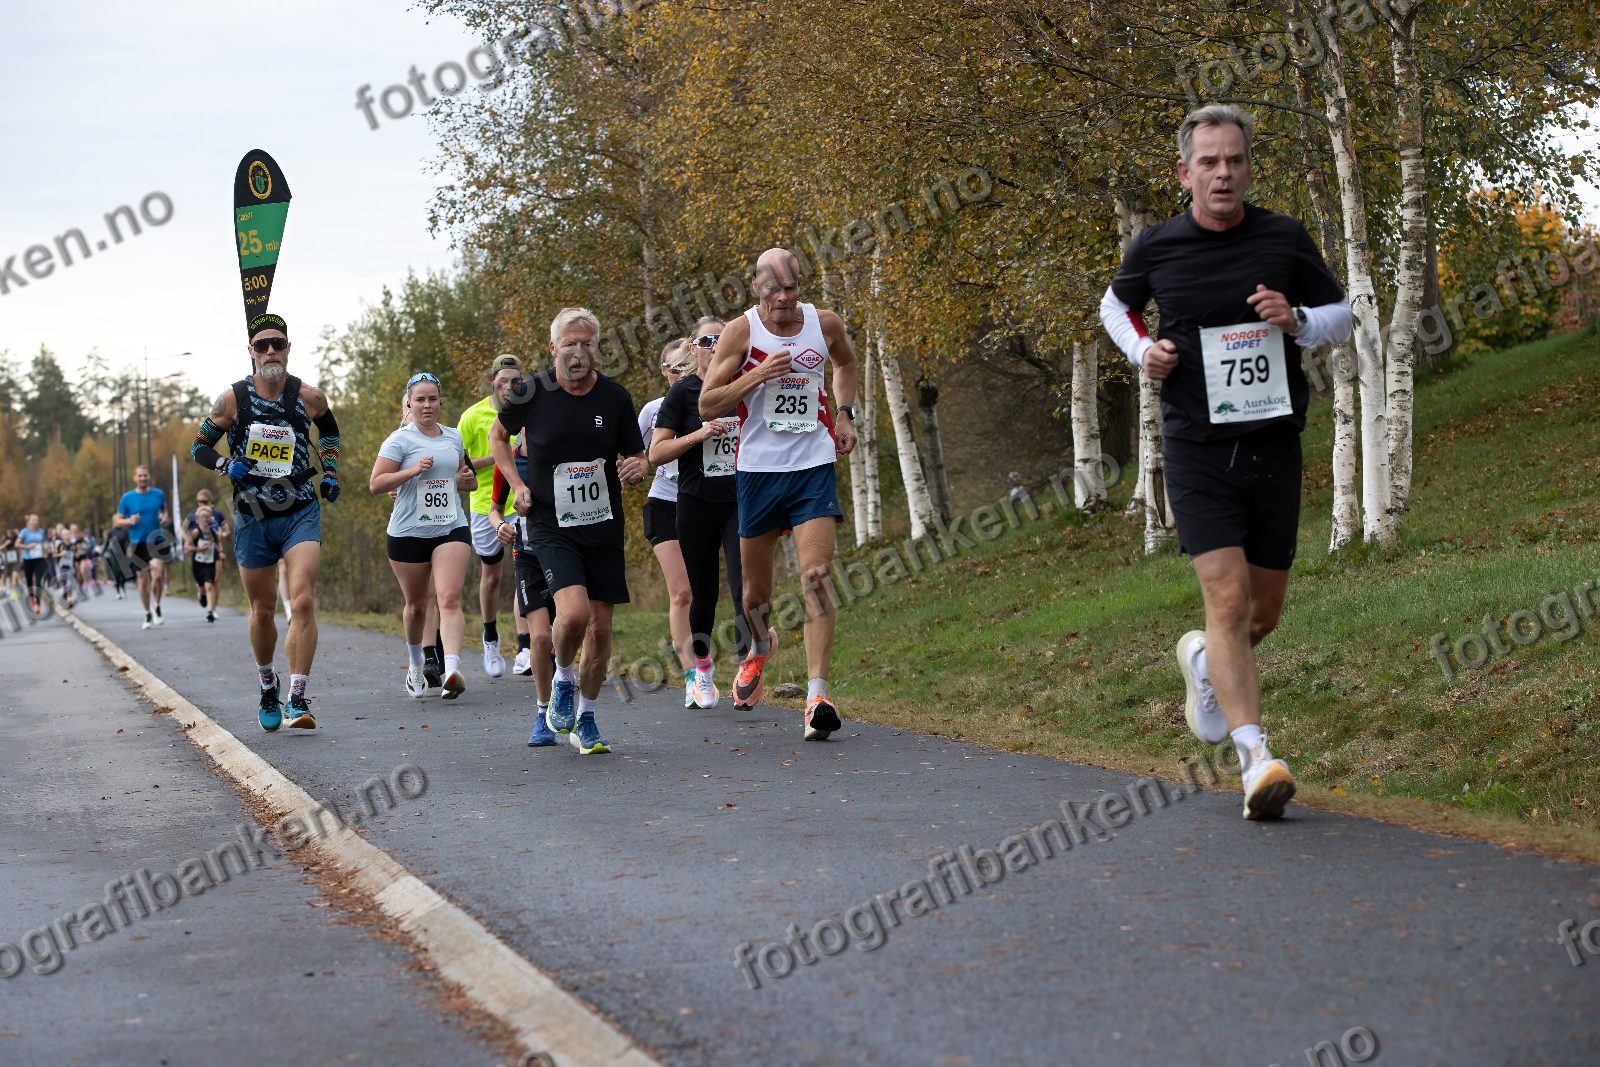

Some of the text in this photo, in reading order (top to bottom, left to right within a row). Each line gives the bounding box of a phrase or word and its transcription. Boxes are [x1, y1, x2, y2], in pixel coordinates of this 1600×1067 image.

[239, 229, 263, 256] 25
[1221, 328, 1270, 343] NORGES
[1226, 339, 1262, 351] LØPET
[1220, 354, 1270, 387] 759
[778, 377, 810, 385] NORGES
[780, 383, 806, 391] LØPET
[774, 394, 808, 415] 235
[1243, 395, 1289, 409] Aurskog
[250, 442, 290, 460] PACE
[565, 464, 599, 474] NORGES
[569, 471, 595, 480] LØPET
[566, 481, 600, 503] 110
[424, 492, 449, 508] 963
